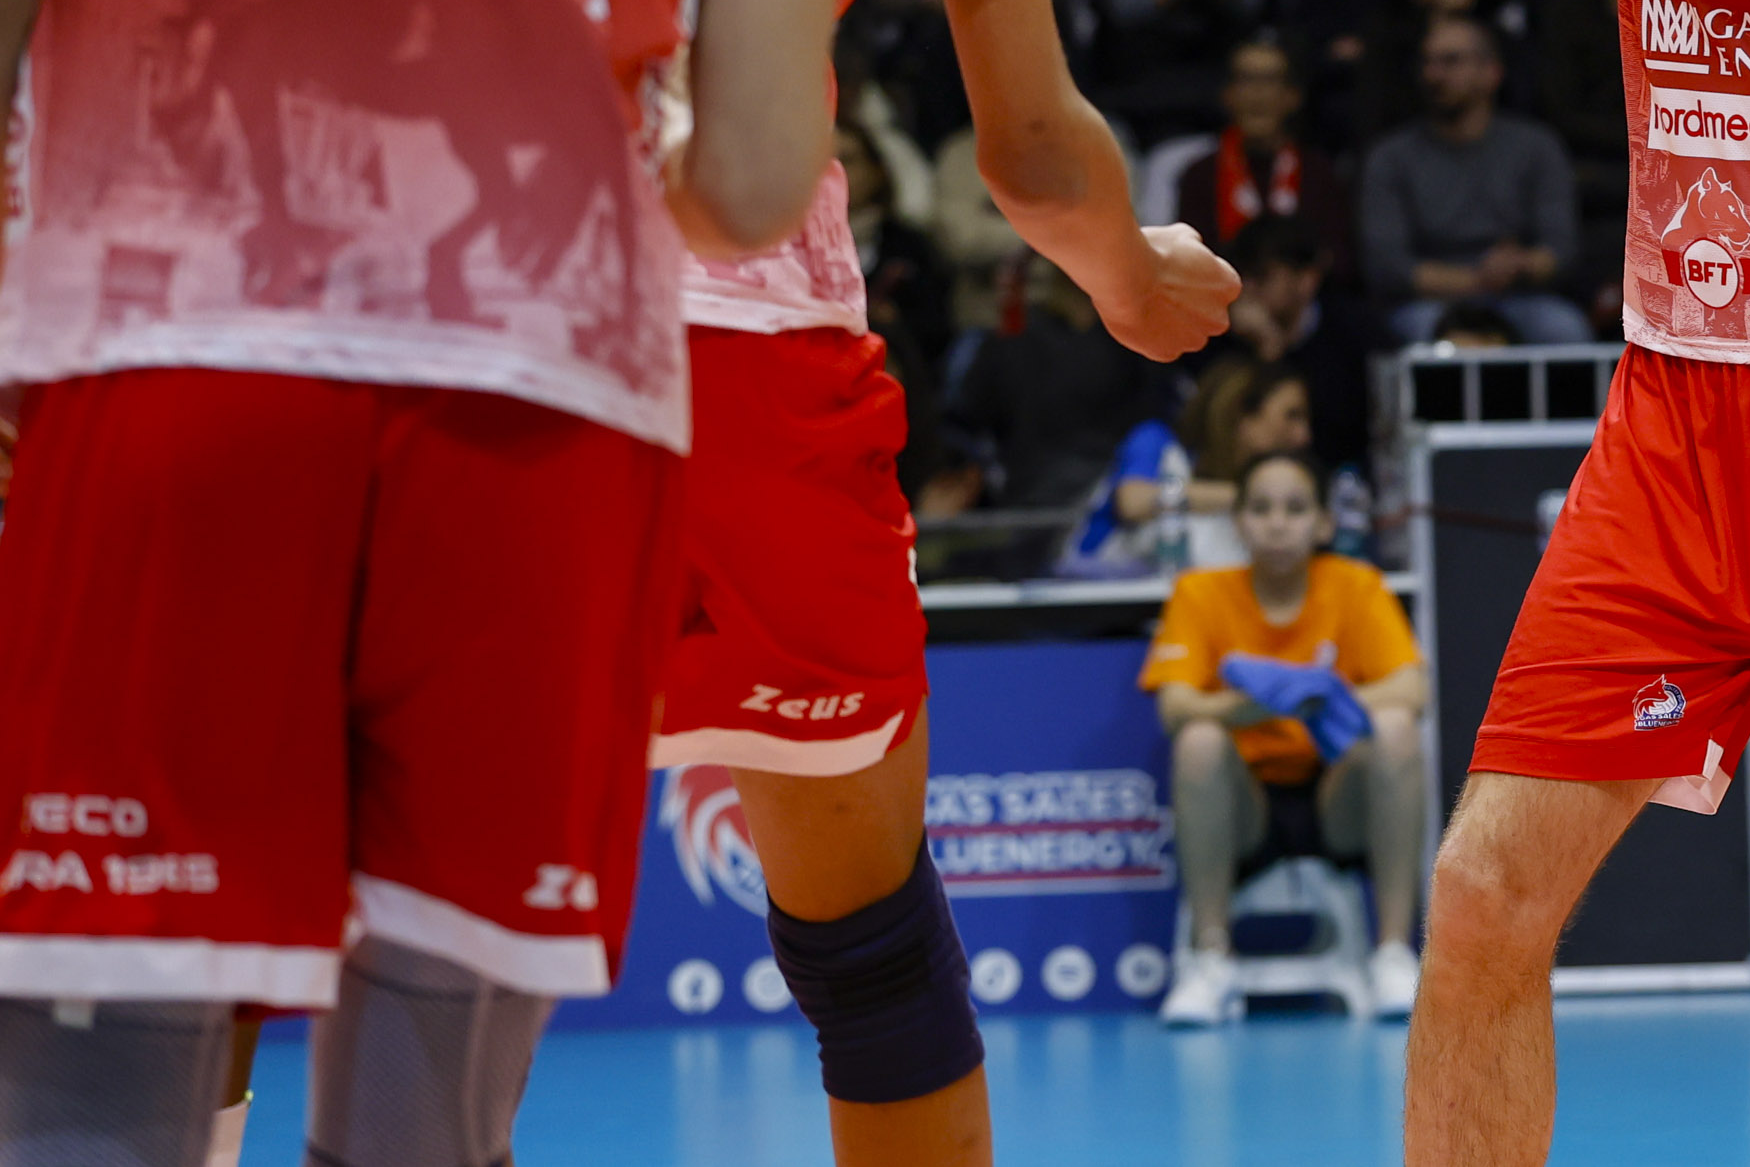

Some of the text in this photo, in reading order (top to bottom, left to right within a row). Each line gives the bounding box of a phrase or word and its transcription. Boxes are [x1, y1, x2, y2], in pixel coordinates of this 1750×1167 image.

[1688, 261, 1733, 287] BFT
[739, 683, 865, 721] Zeus
[927, 830, 1160, 876] LUENERGY
